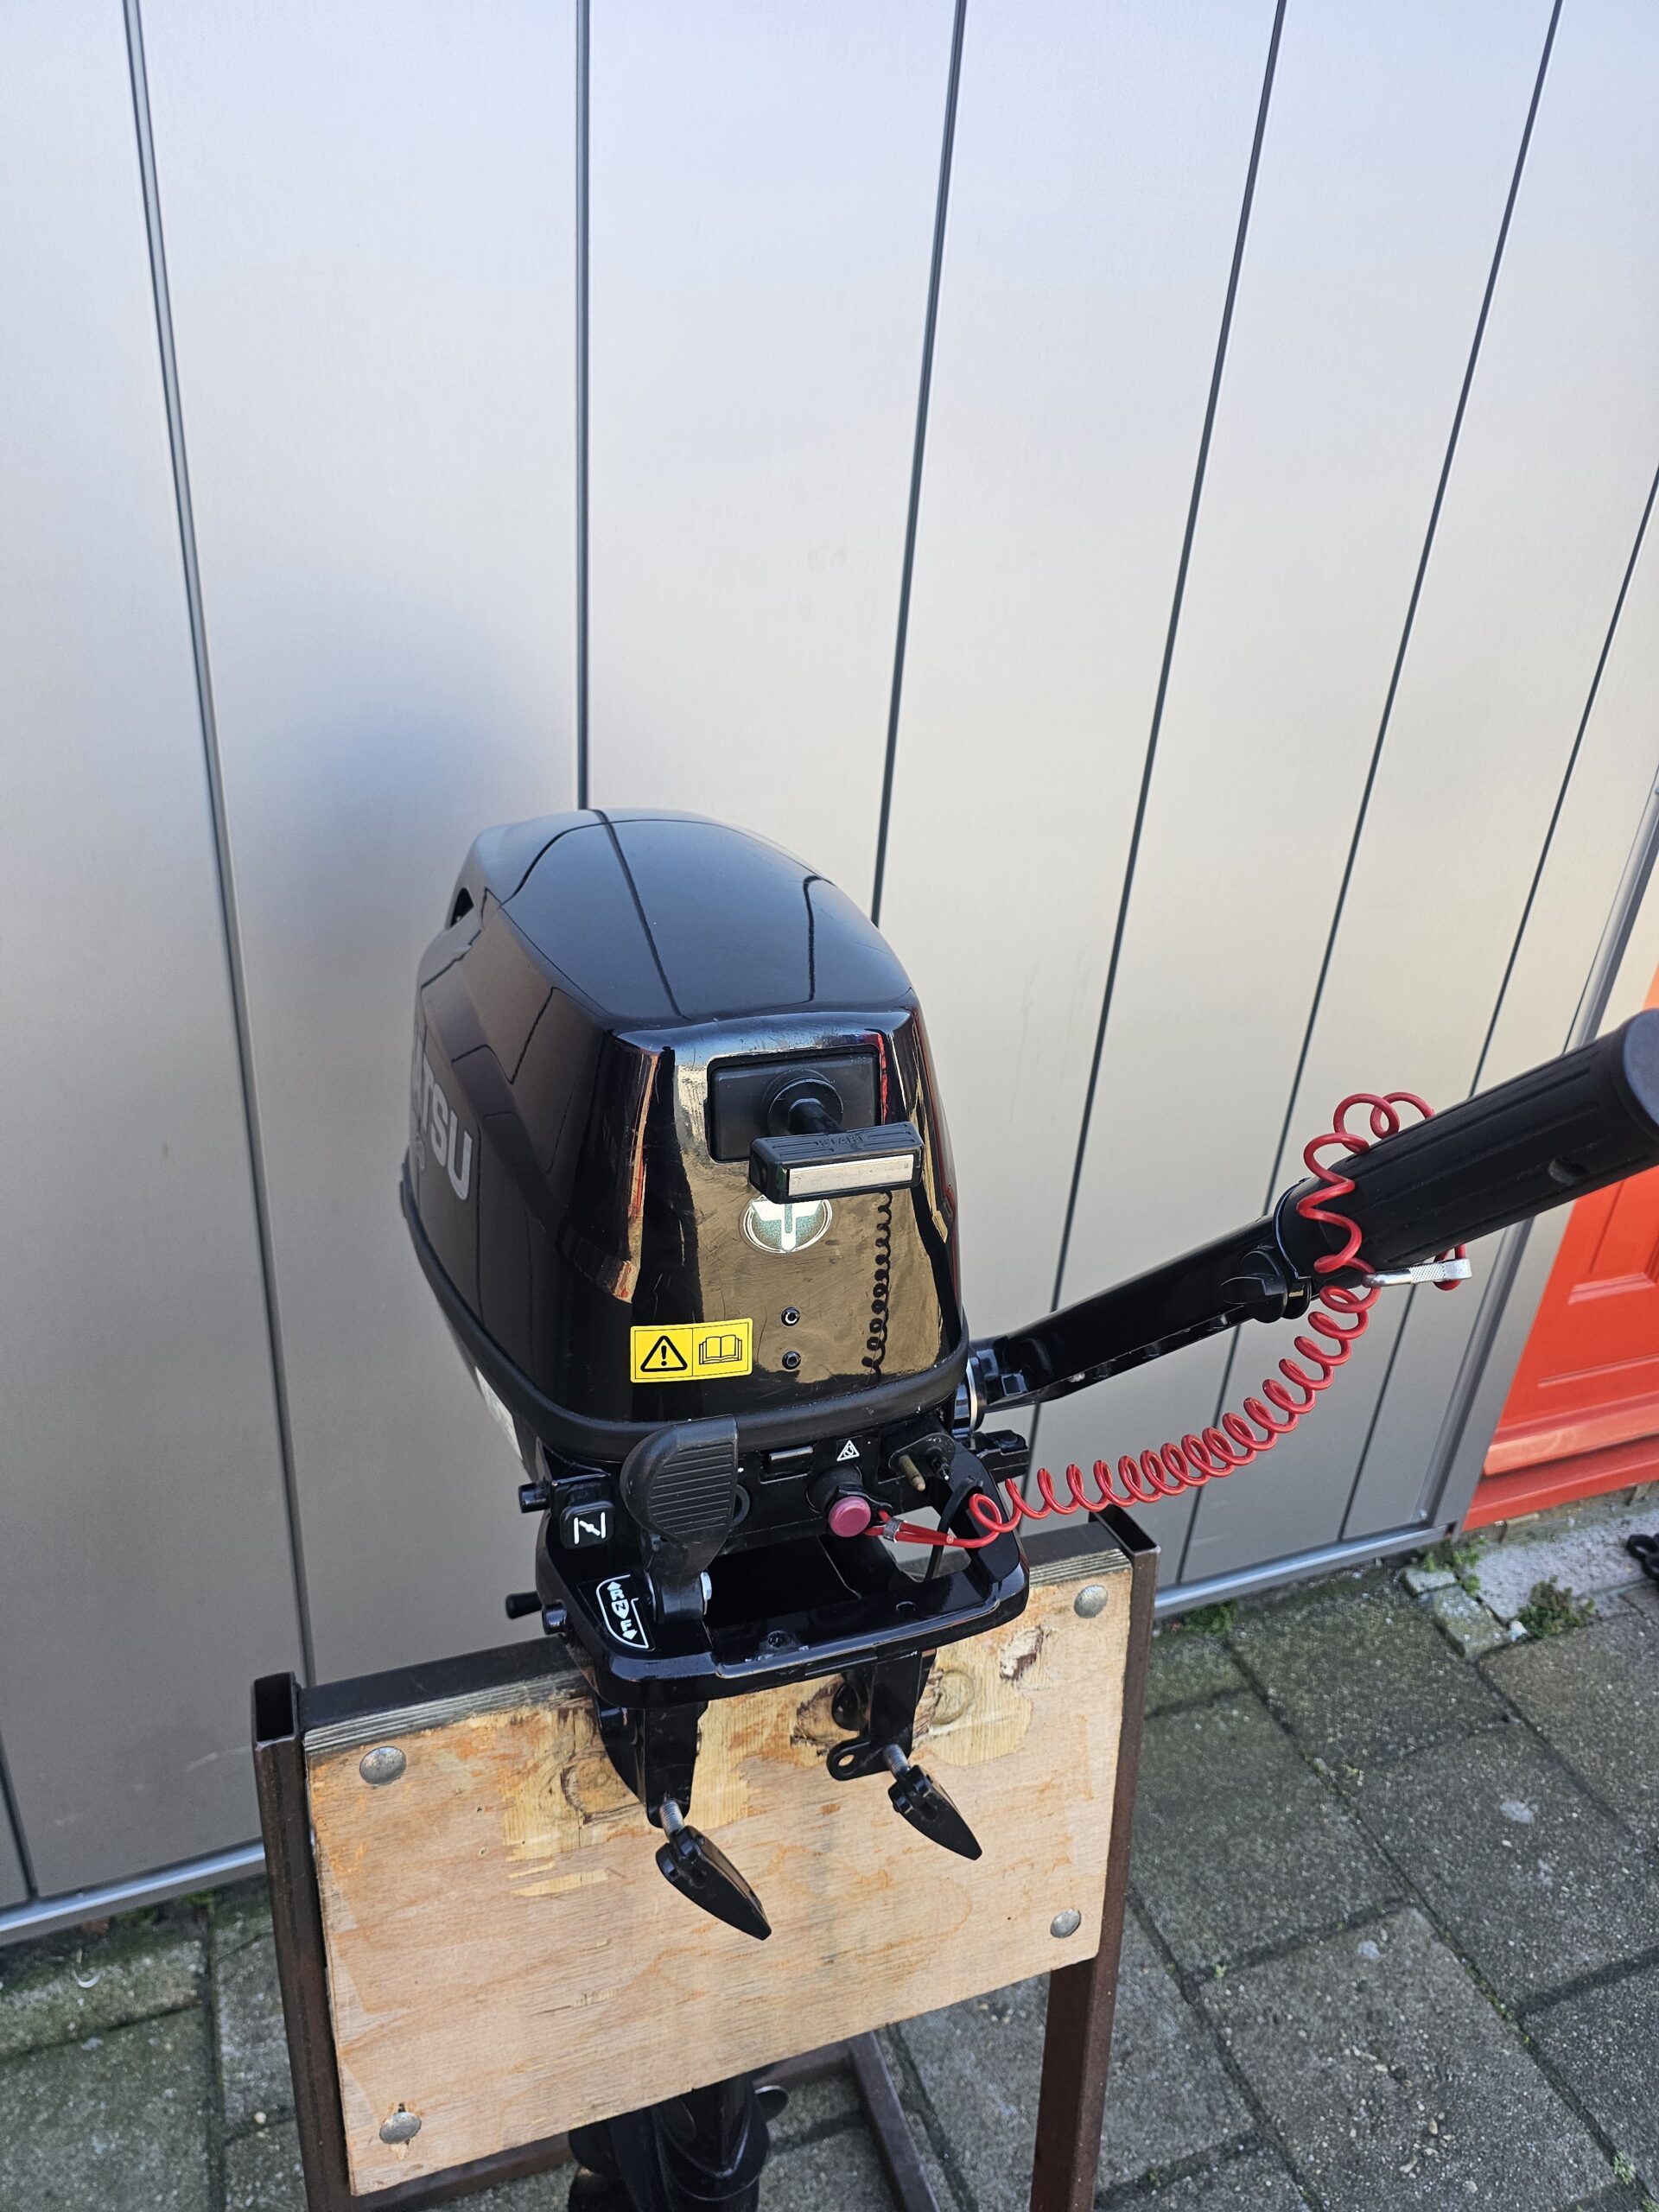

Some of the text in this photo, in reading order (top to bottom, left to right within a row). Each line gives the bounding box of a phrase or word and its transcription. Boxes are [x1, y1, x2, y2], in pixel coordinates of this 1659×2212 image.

[415, 1046, 473, 1200] TSU
[819, 1134, 864, 1147] START
[610, 1588, 625, 1601] R
[620, 1618, 632, 1631] F
